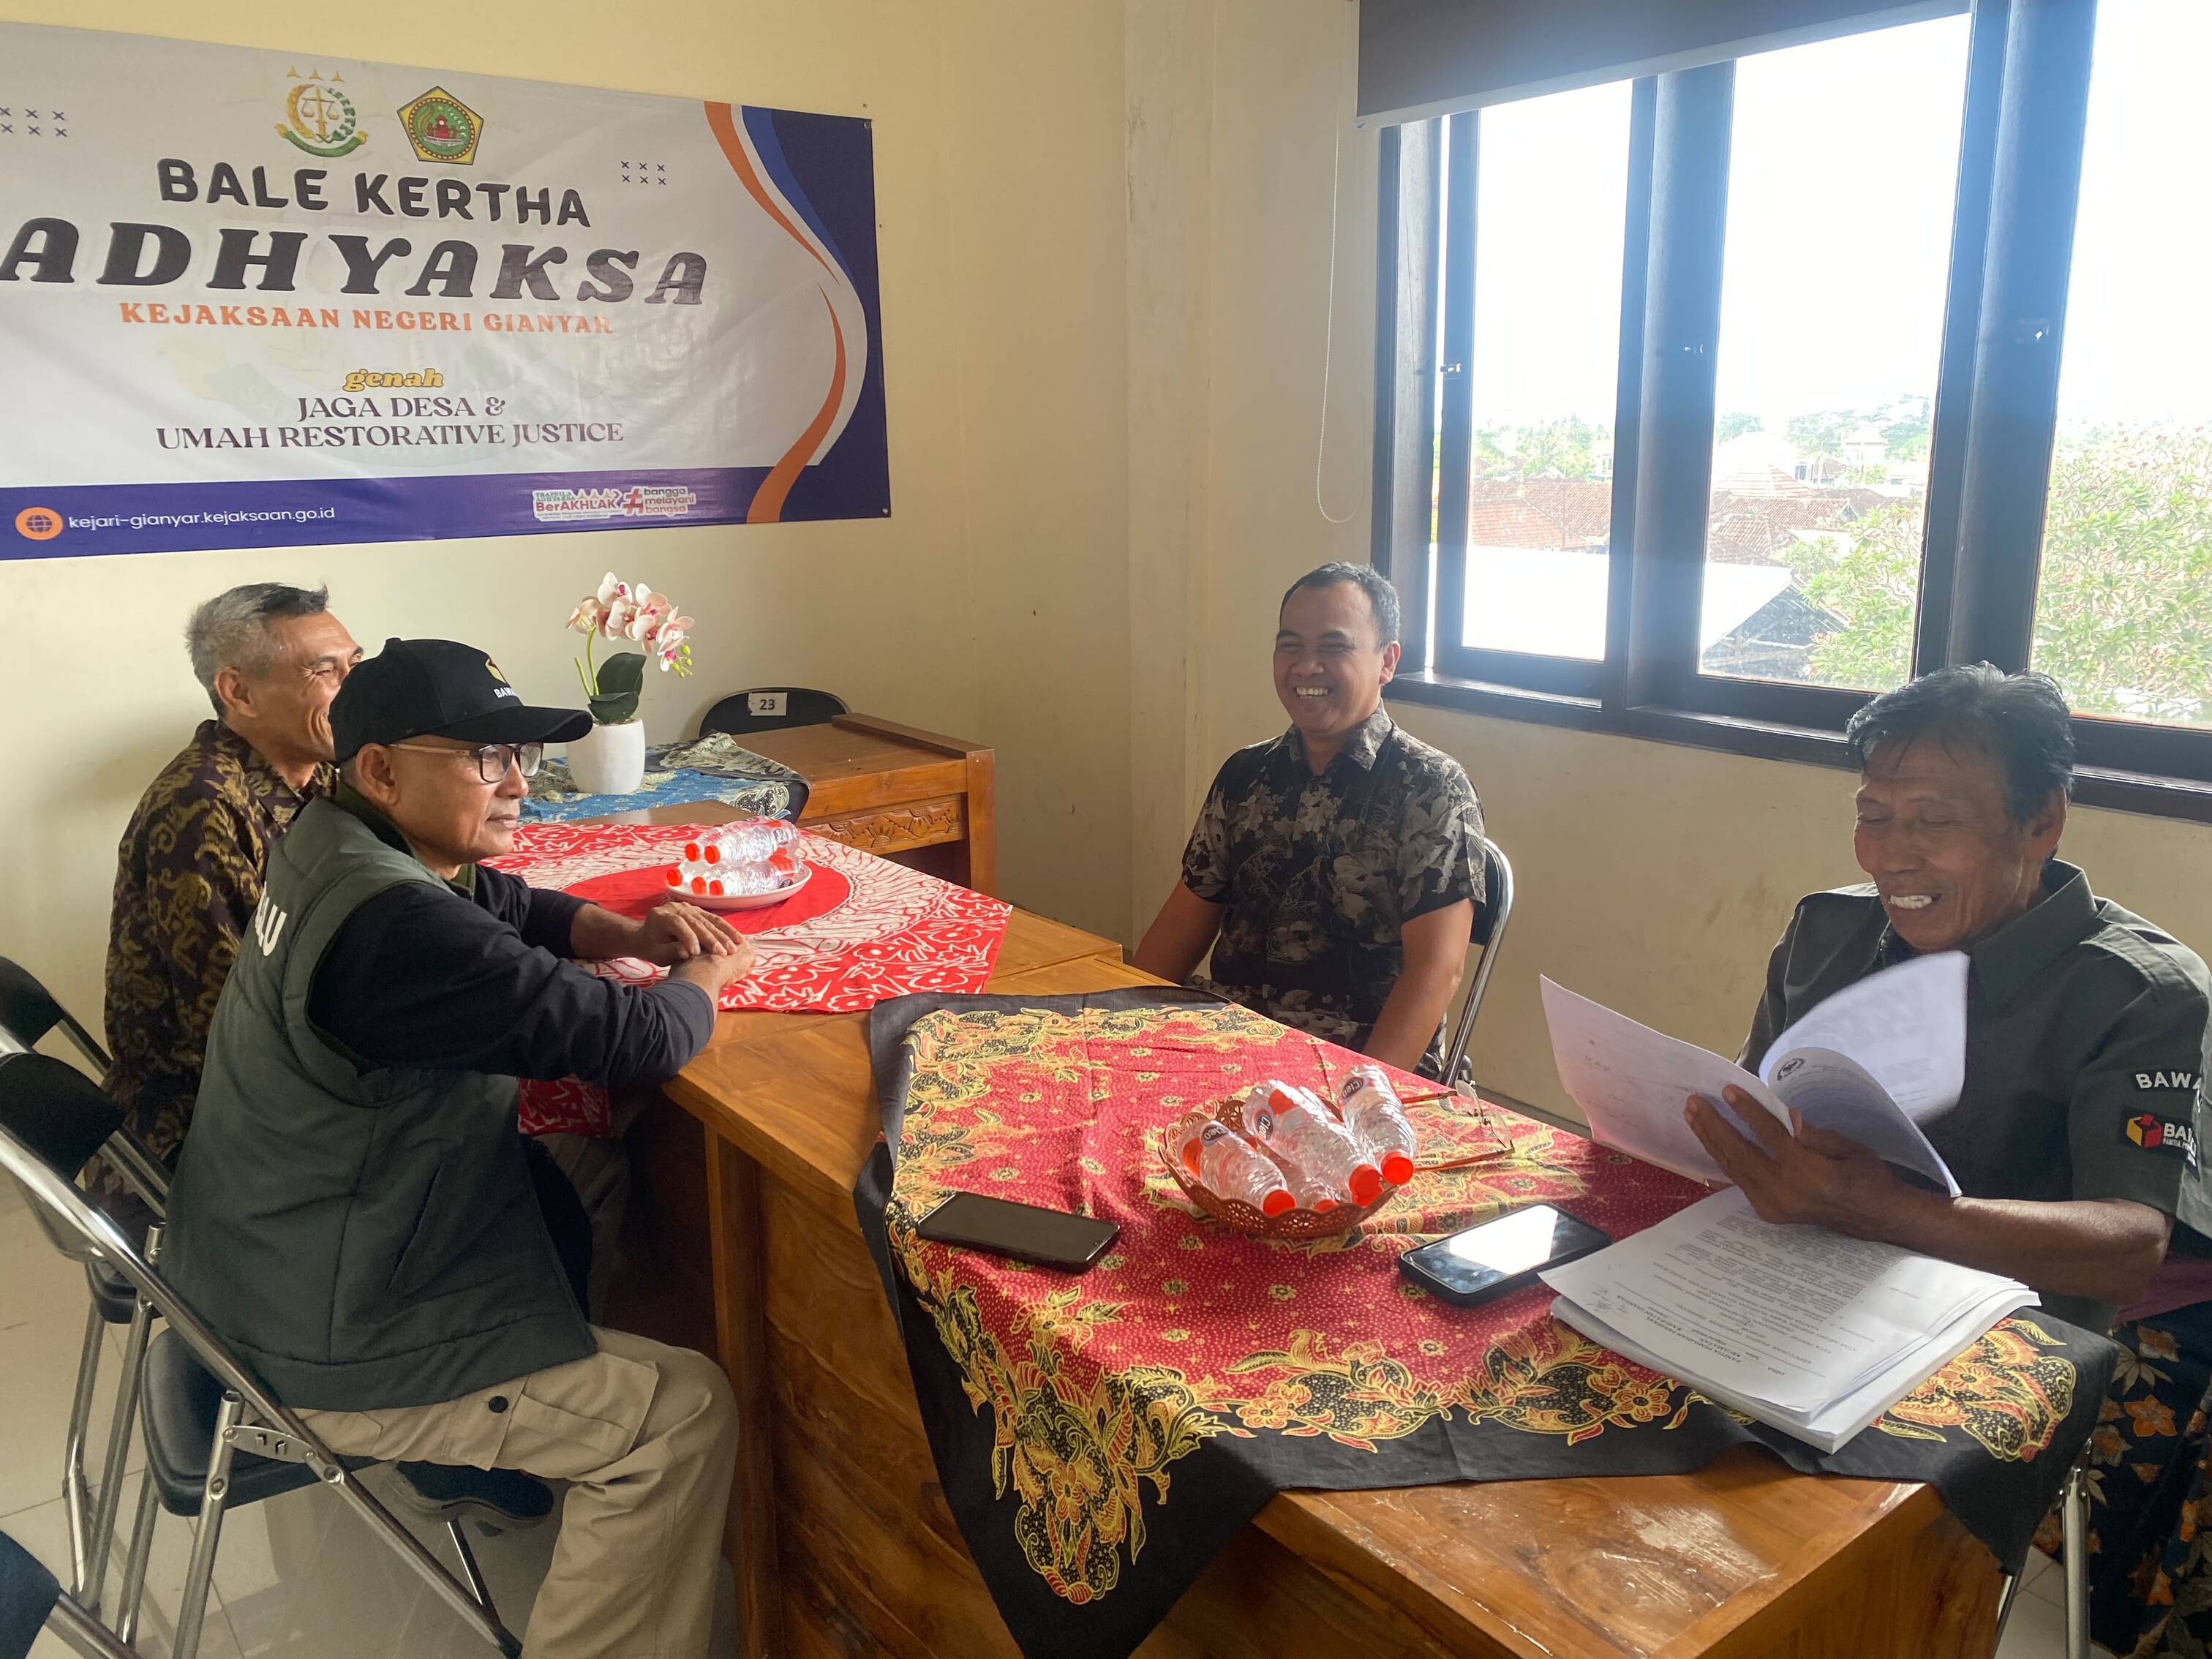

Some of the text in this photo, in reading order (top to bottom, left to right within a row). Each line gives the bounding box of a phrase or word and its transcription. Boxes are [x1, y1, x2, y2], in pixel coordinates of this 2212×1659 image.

[158, 158, 591, 227] BALE KERTHA
[0, 217, 707, 305] ADHYAKSA
[120, 302, 614, 334] KEJAKSAAN NEGERI GIANYAR
[342, 368, 445, 393] genah
[297, 396, 506, 422] JAGA DESA &
[156, 422, 624, 450] UMAH RESTORATIVE JUSTICE
[69, 507, 335, 530] kejari-gianyar.kejaksaan.go.id
[759, 699, 775, 710] 23
[1258, 1116, 1271, 1139] Cleo
